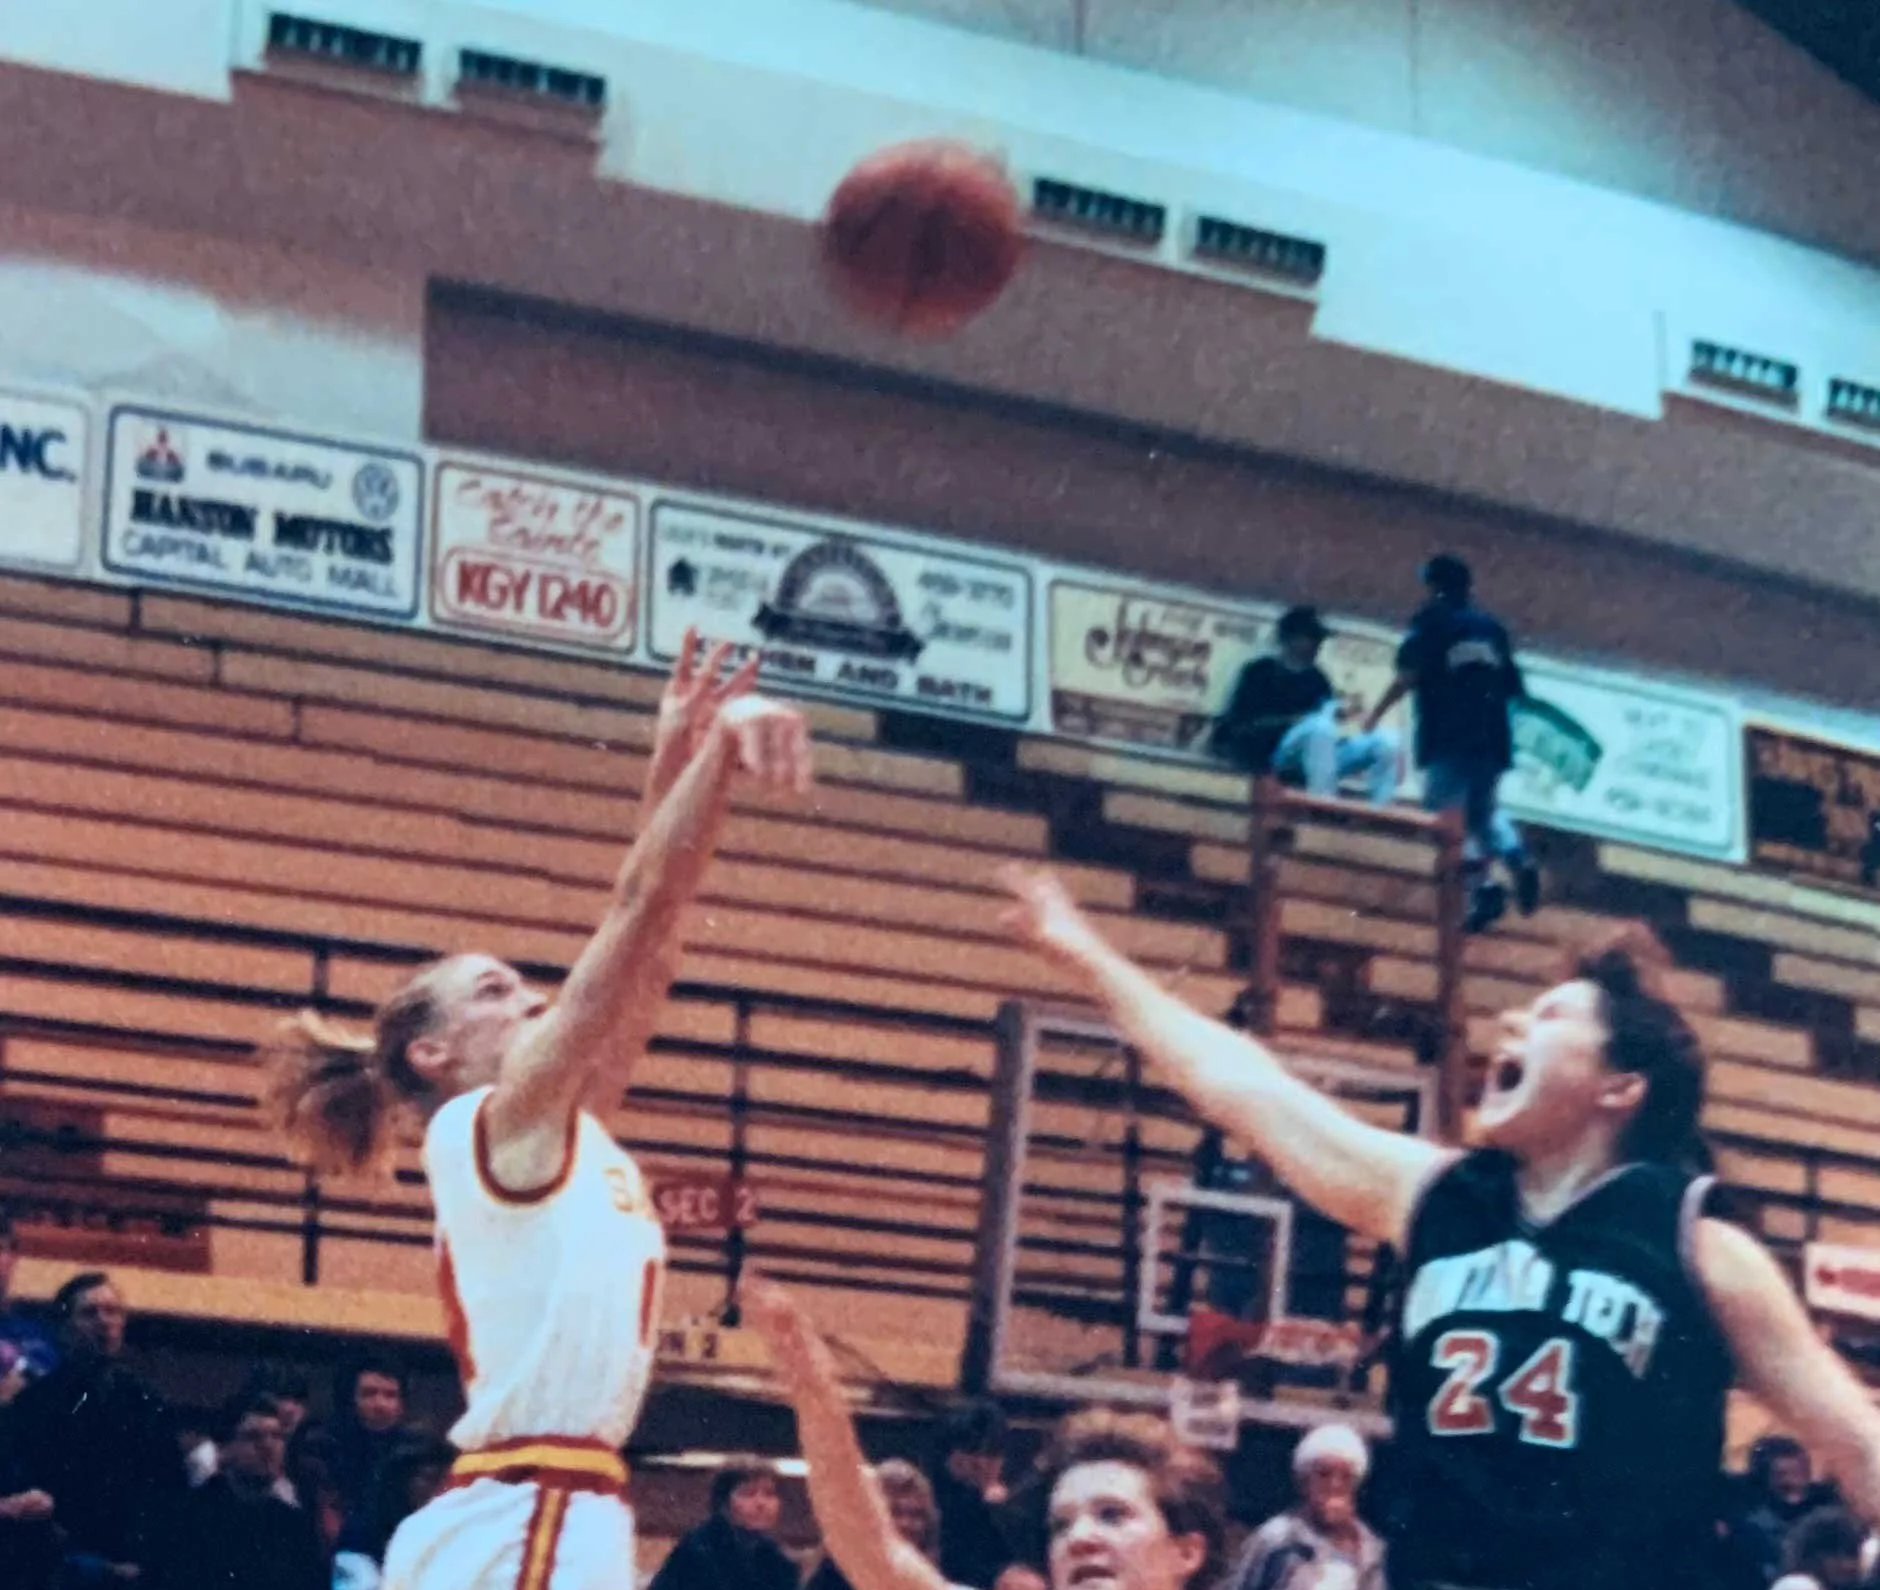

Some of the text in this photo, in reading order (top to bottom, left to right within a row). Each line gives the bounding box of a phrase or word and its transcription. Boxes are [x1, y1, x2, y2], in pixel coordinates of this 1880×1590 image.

[122, 529, 396, 600] CAPITAL AUTO MALL
[274, 511, 394, 564] MOTORS
[458, 561, 618, 629] KGY 1240
[836, 660, 900, 689] AND
[915, 676, 993, 702] BATH
[659, 1187, 719, 1224] SEC
[735, 1185, 755, 1224] 2
[1427, 1328, 1581, 1450] 24
